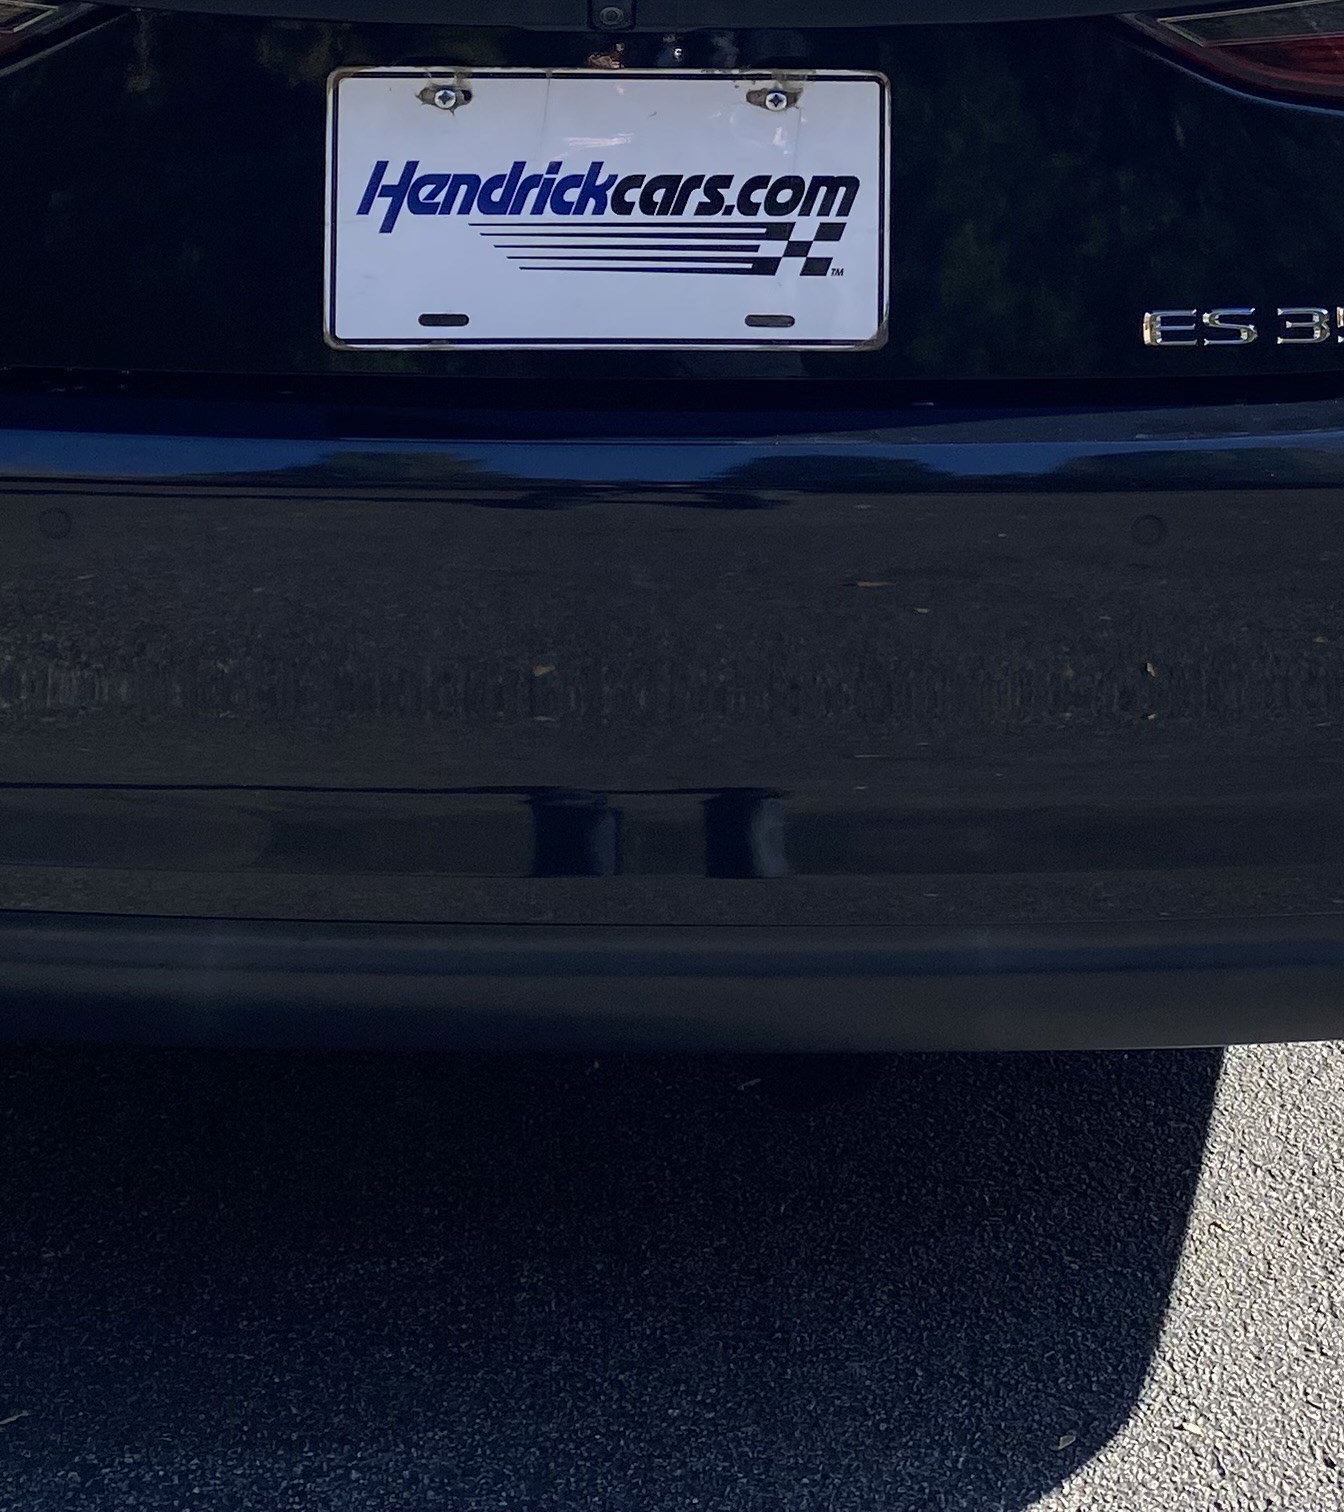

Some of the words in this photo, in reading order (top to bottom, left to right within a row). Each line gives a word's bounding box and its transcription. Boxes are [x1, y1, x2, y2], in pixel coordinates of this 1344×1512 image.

[357, 160, 860, 234] Hendrickcars.com
[831, 268, 844, 276] TM
[1143, 308, 1257, 346] ES
